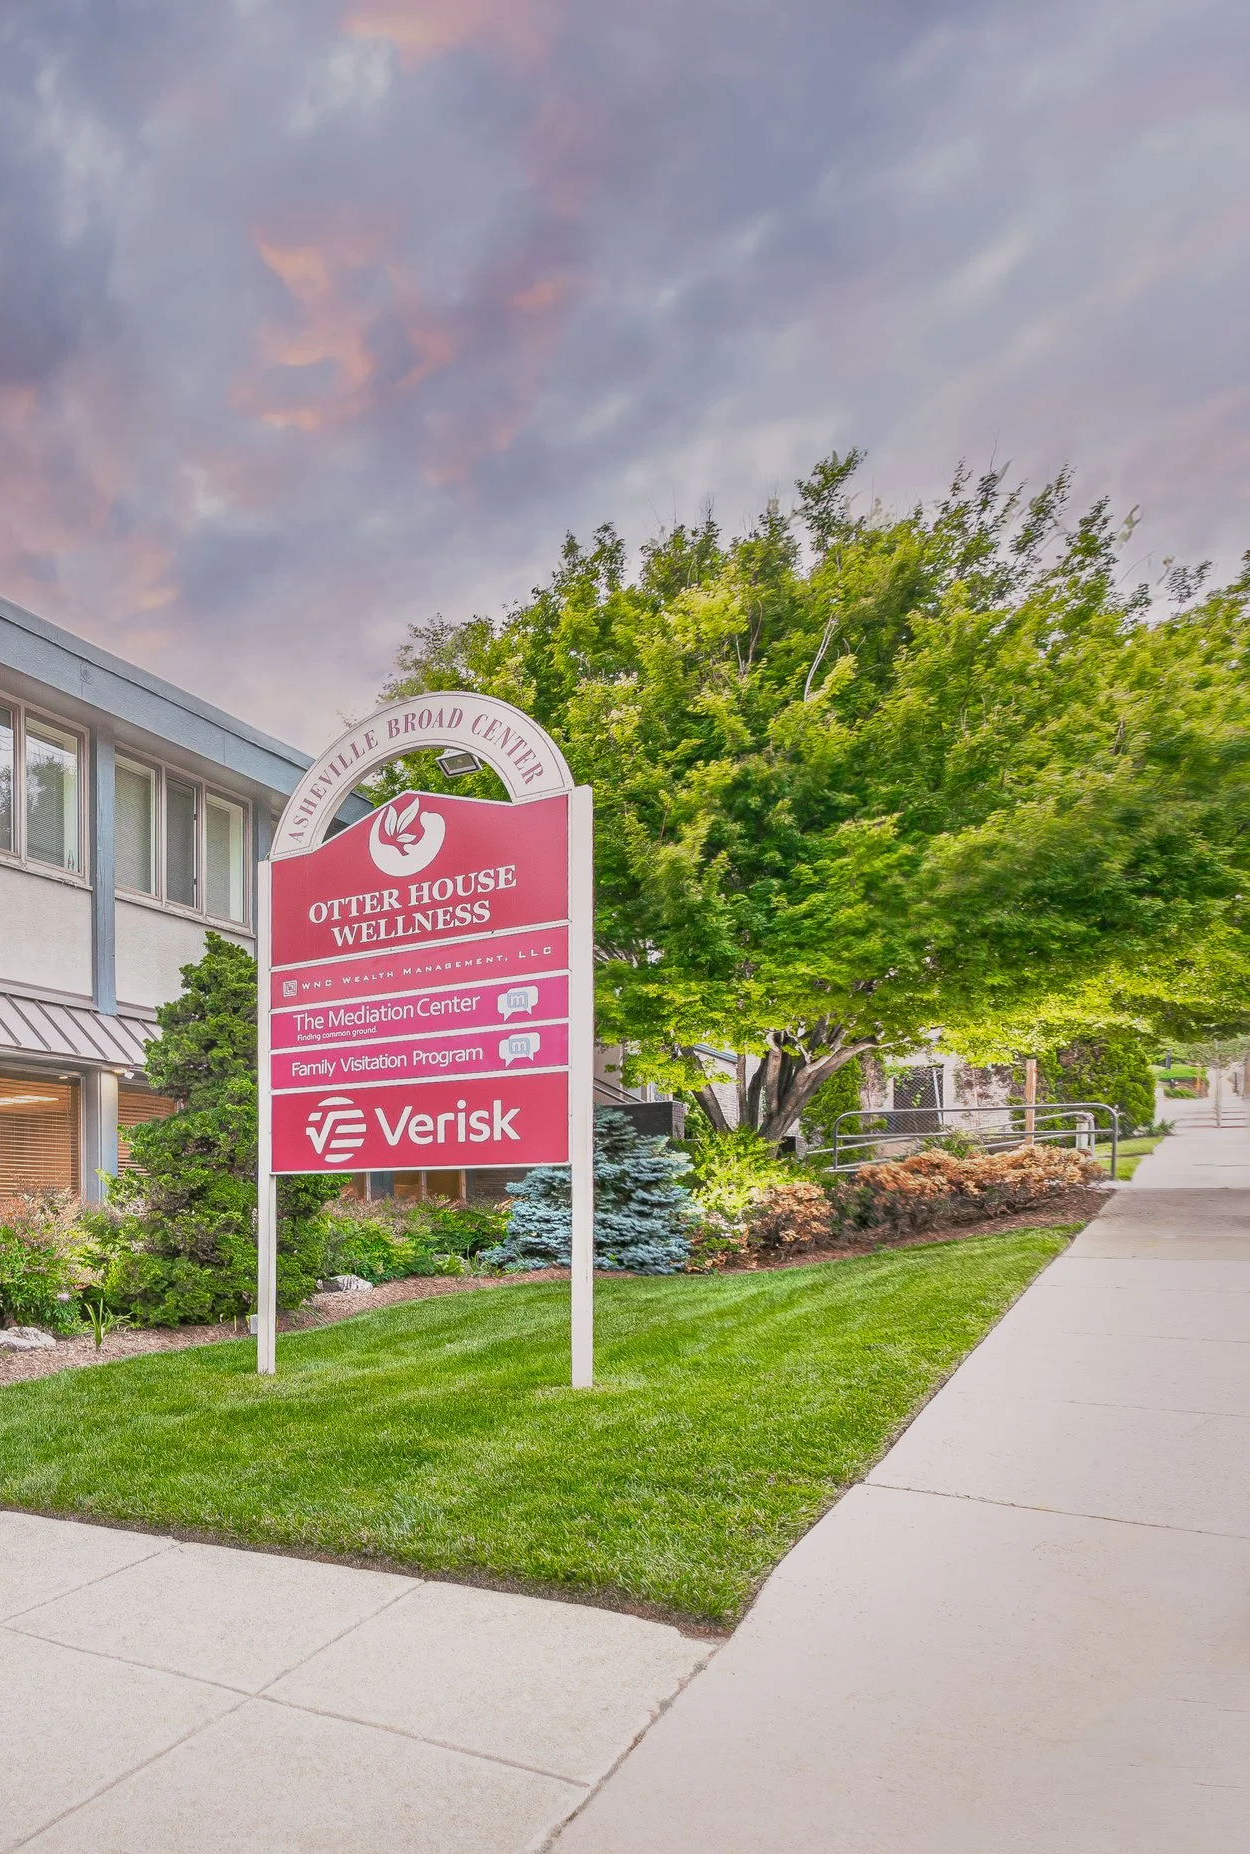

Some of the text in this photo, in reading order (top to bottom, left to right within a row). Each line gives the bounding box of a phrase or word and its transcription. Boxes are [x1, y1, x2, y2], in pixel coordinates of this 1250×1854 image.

[288, 707, 544, 844] ASHEVILLE BROAD CENTER
[308, 864, 518, 925] OTTER HOUSE
[330, 899, 492, 947] WELLNESS
[301, 979, 333, 990] WNC
[342, 971, 395, 985] WEALTH
[518, 946, 552, 959] LLC
[293, 995, 481, 1032] The Mediation Center
[297, 1026, 377, 1041] Finding common ground.
[291, 1047, 483, 1079] Family Visitation Program
[374, 1099, 521, 1147] Verisk
